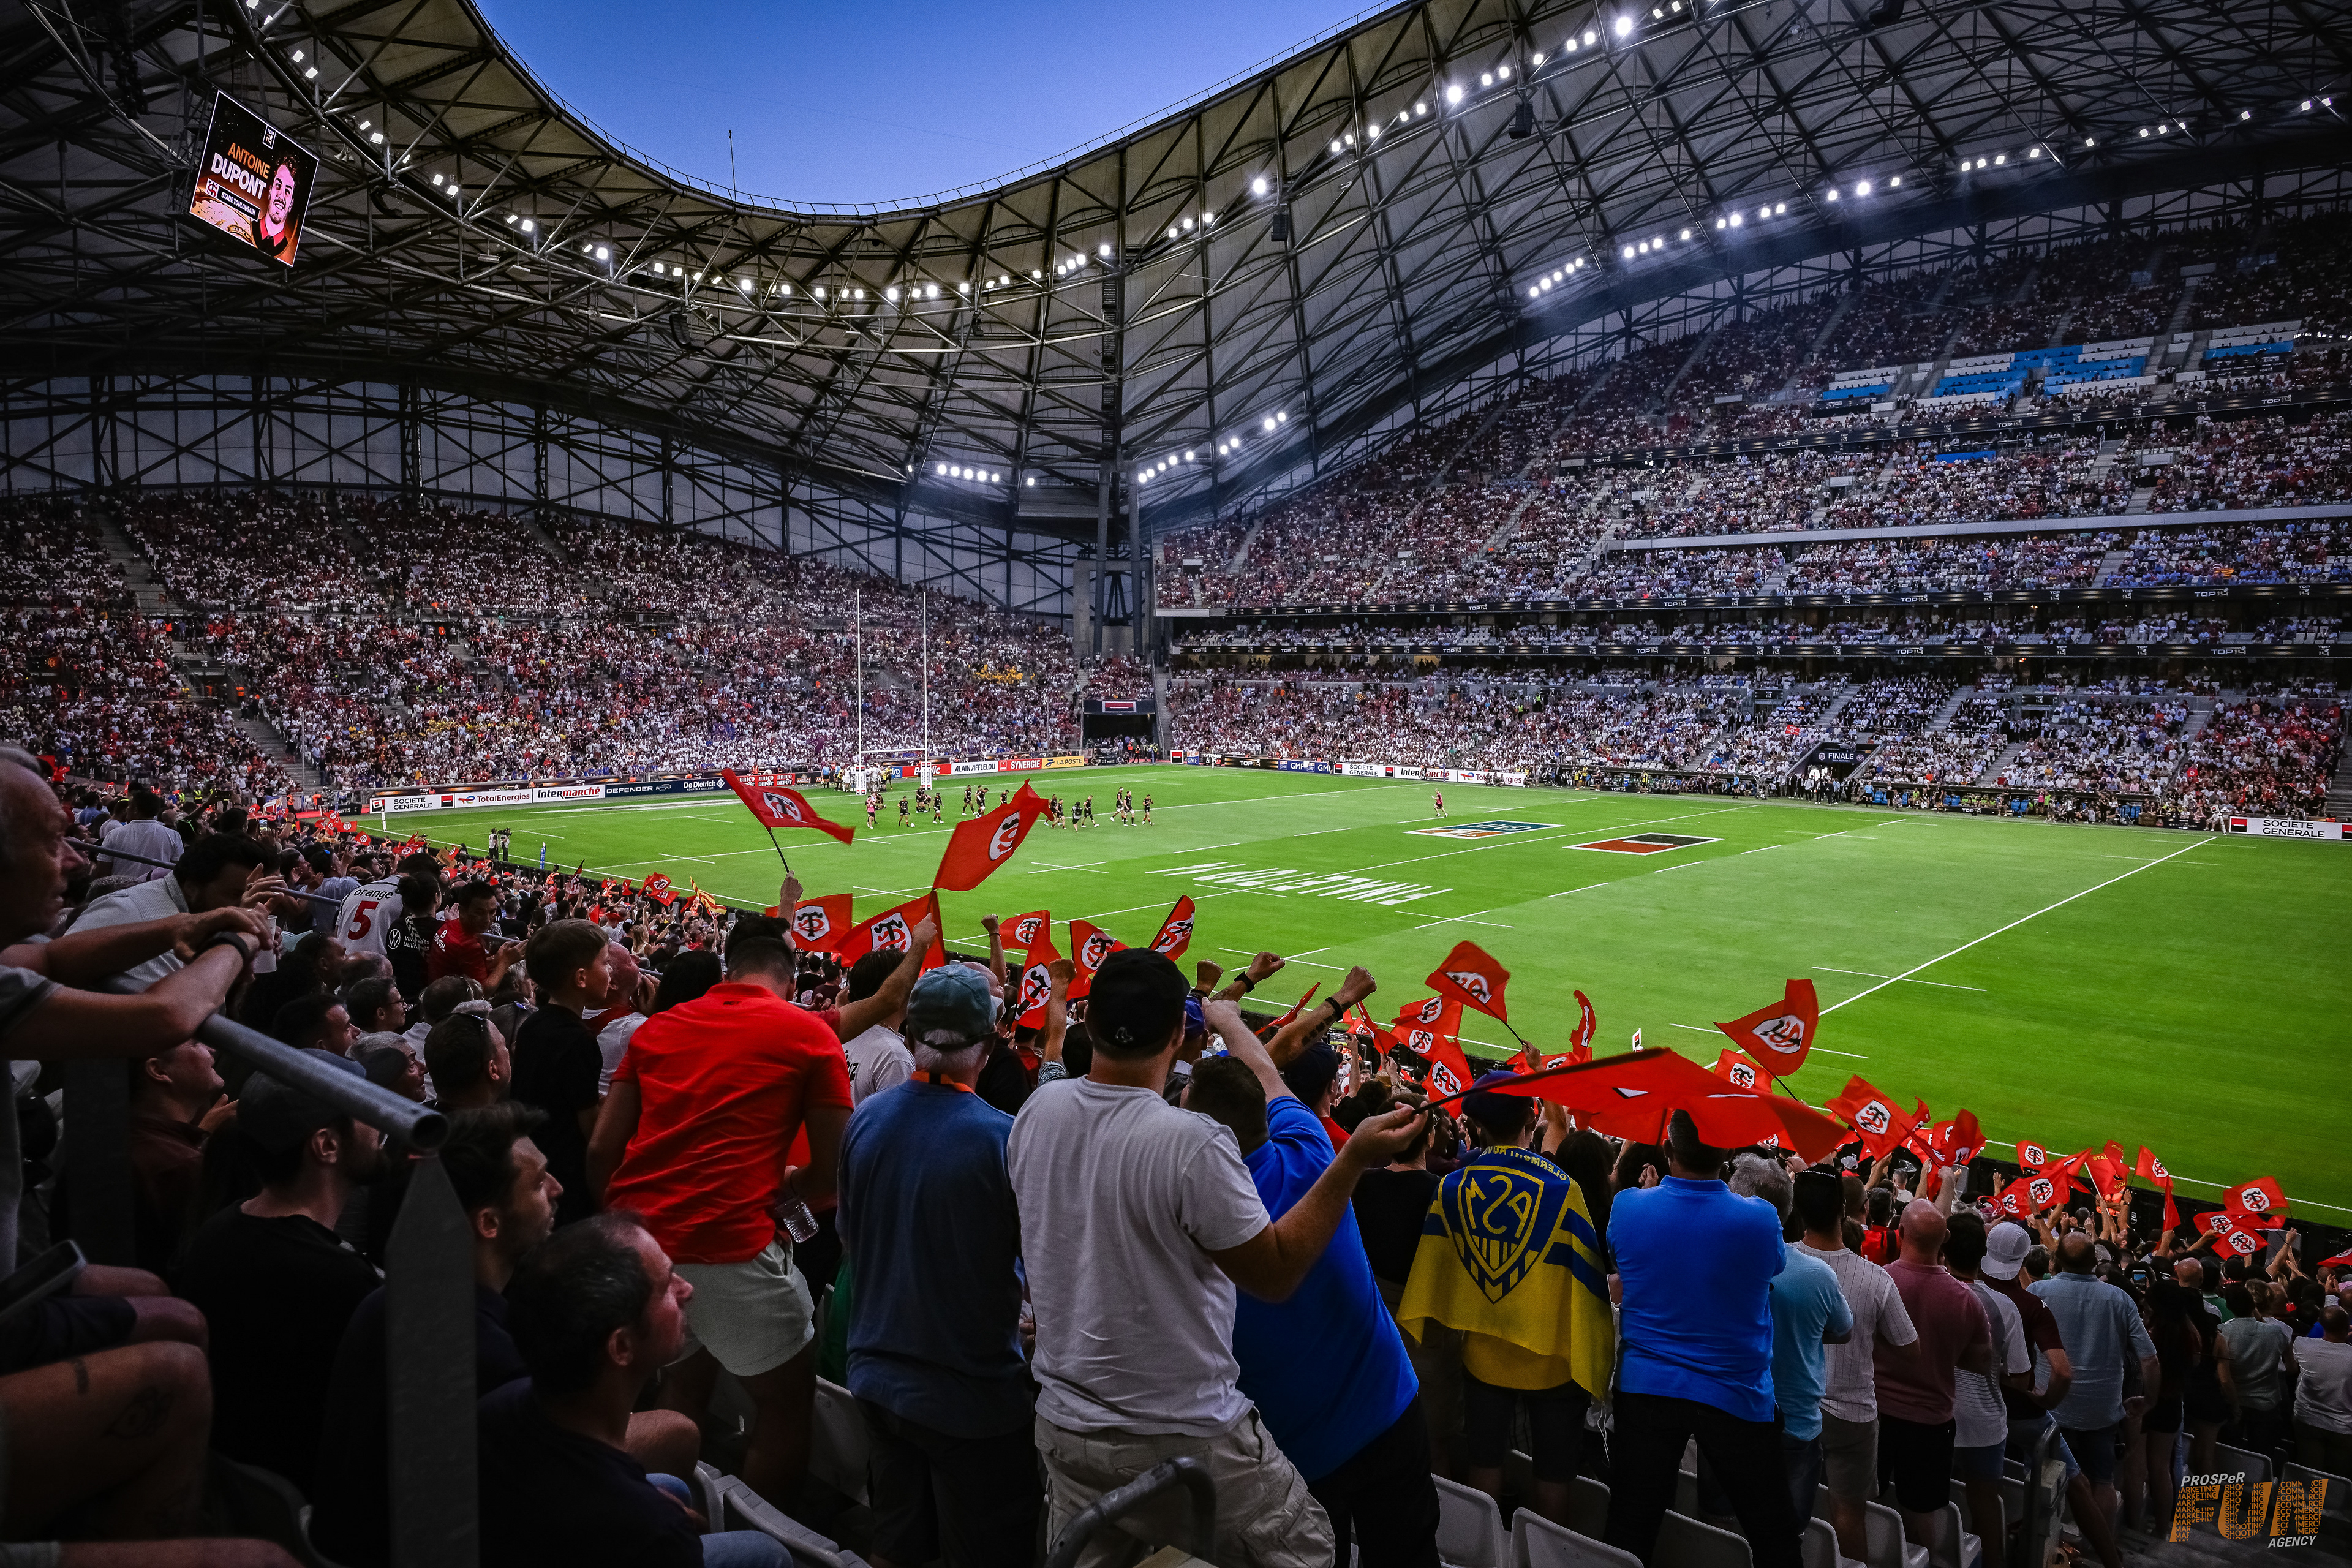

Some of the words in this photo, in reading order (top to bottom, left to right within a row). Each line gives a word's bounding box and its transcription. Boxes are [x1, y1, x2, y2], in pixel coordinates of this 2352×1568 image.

[227, 142, 271, 179] ANTOINE
[211, 152, 267, 200] DUPONT
[221, 191, 234, 204] STADE
[233, 198, 256, 216] TOULOUSAIN
[1010, 760, 1041, 769] SYNERGIE
[693, 780, 716, 788] Dietrich
[477, 793, 531, 803] TotalEnergies
[2263, 819, 2314, 829] SOCIETE
[2263, 827, 2326, 838] GENERALE
[353, 888, 393, 900] orange
[347, 900, 380, 940] 5
